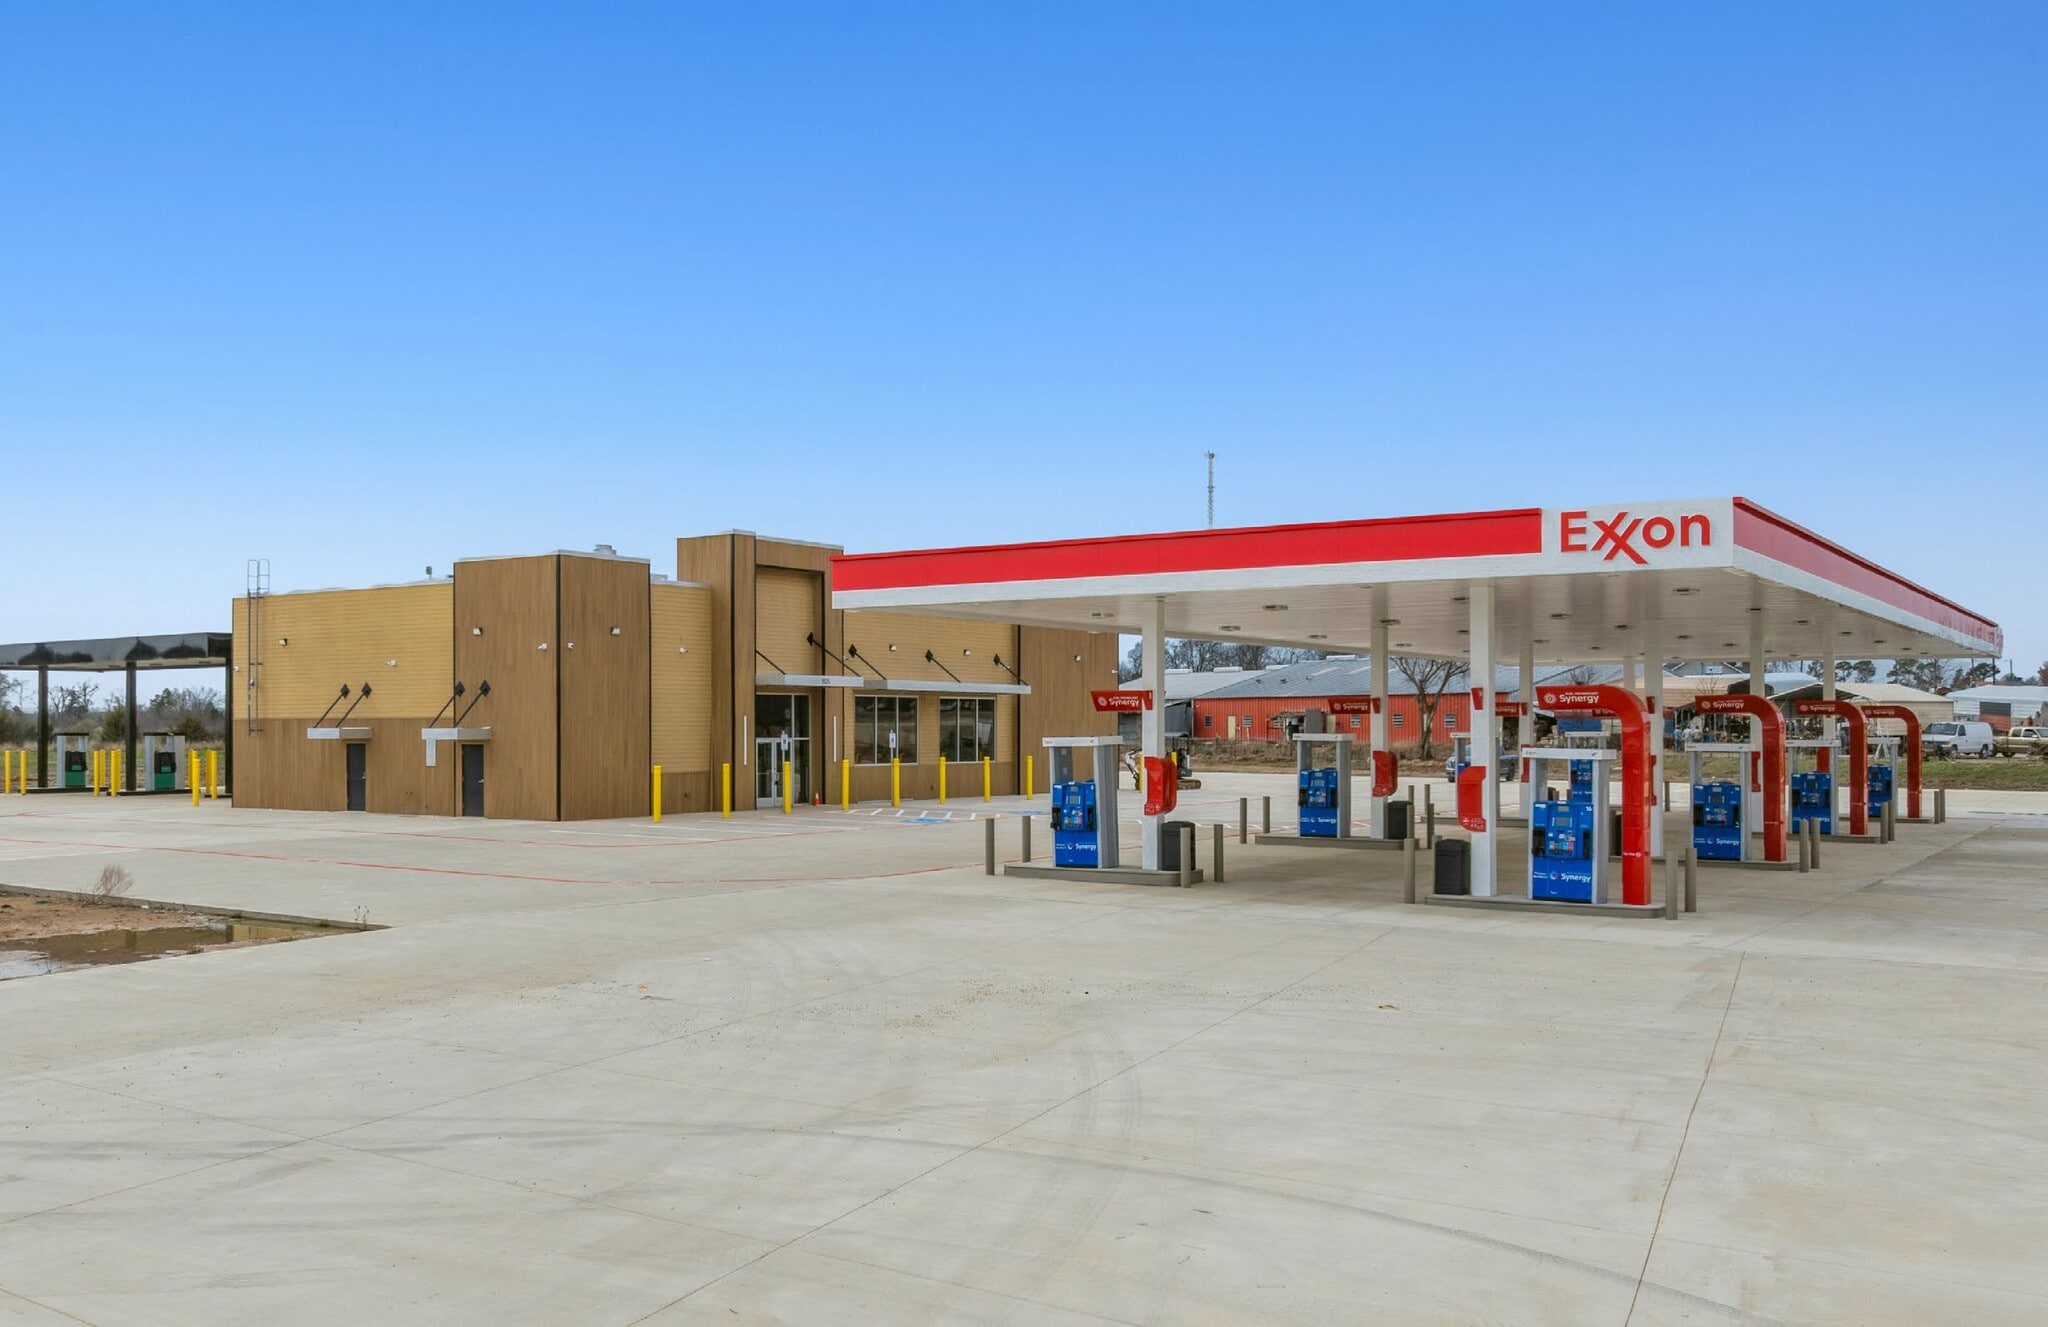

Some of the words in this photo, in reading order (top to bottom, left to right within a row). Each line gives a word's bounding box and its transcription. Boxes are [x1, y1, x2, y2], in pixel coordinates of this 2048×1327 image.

[1560, 511, 1710, 564] Exxon
[1109, 698, 1140, 707] Synergy
[1559, 694, 1599, 704] Synergy
[1561, 872, 1591, 883] Synergy
